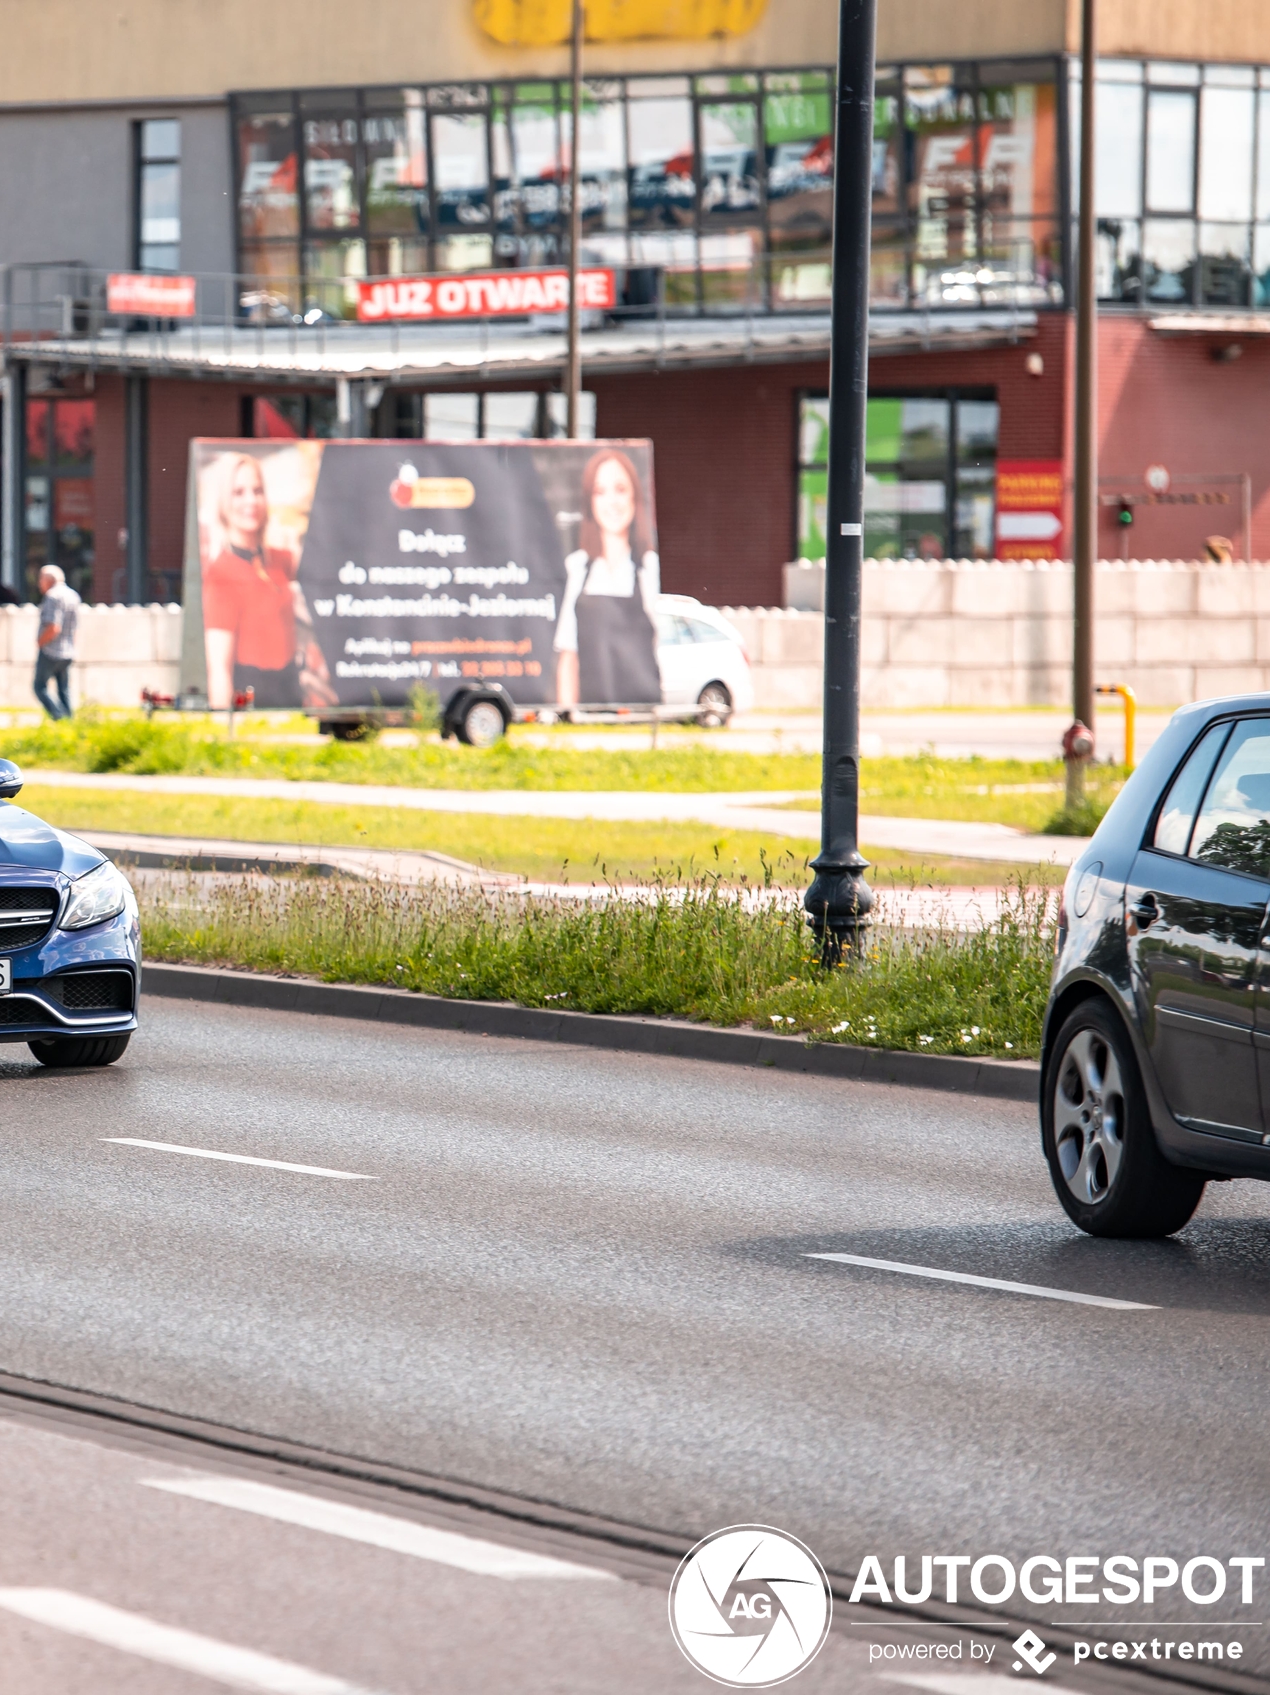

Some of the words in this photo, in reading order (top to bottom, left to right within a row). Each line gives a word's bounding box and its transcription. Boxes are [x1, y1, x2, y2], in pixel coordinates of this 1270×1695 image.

[338, 560, 367, 585] do
[369, 566, 452, 590] naszego
[453, 561, 530, 589] zespołu
[314, 599, 335, 617] w
